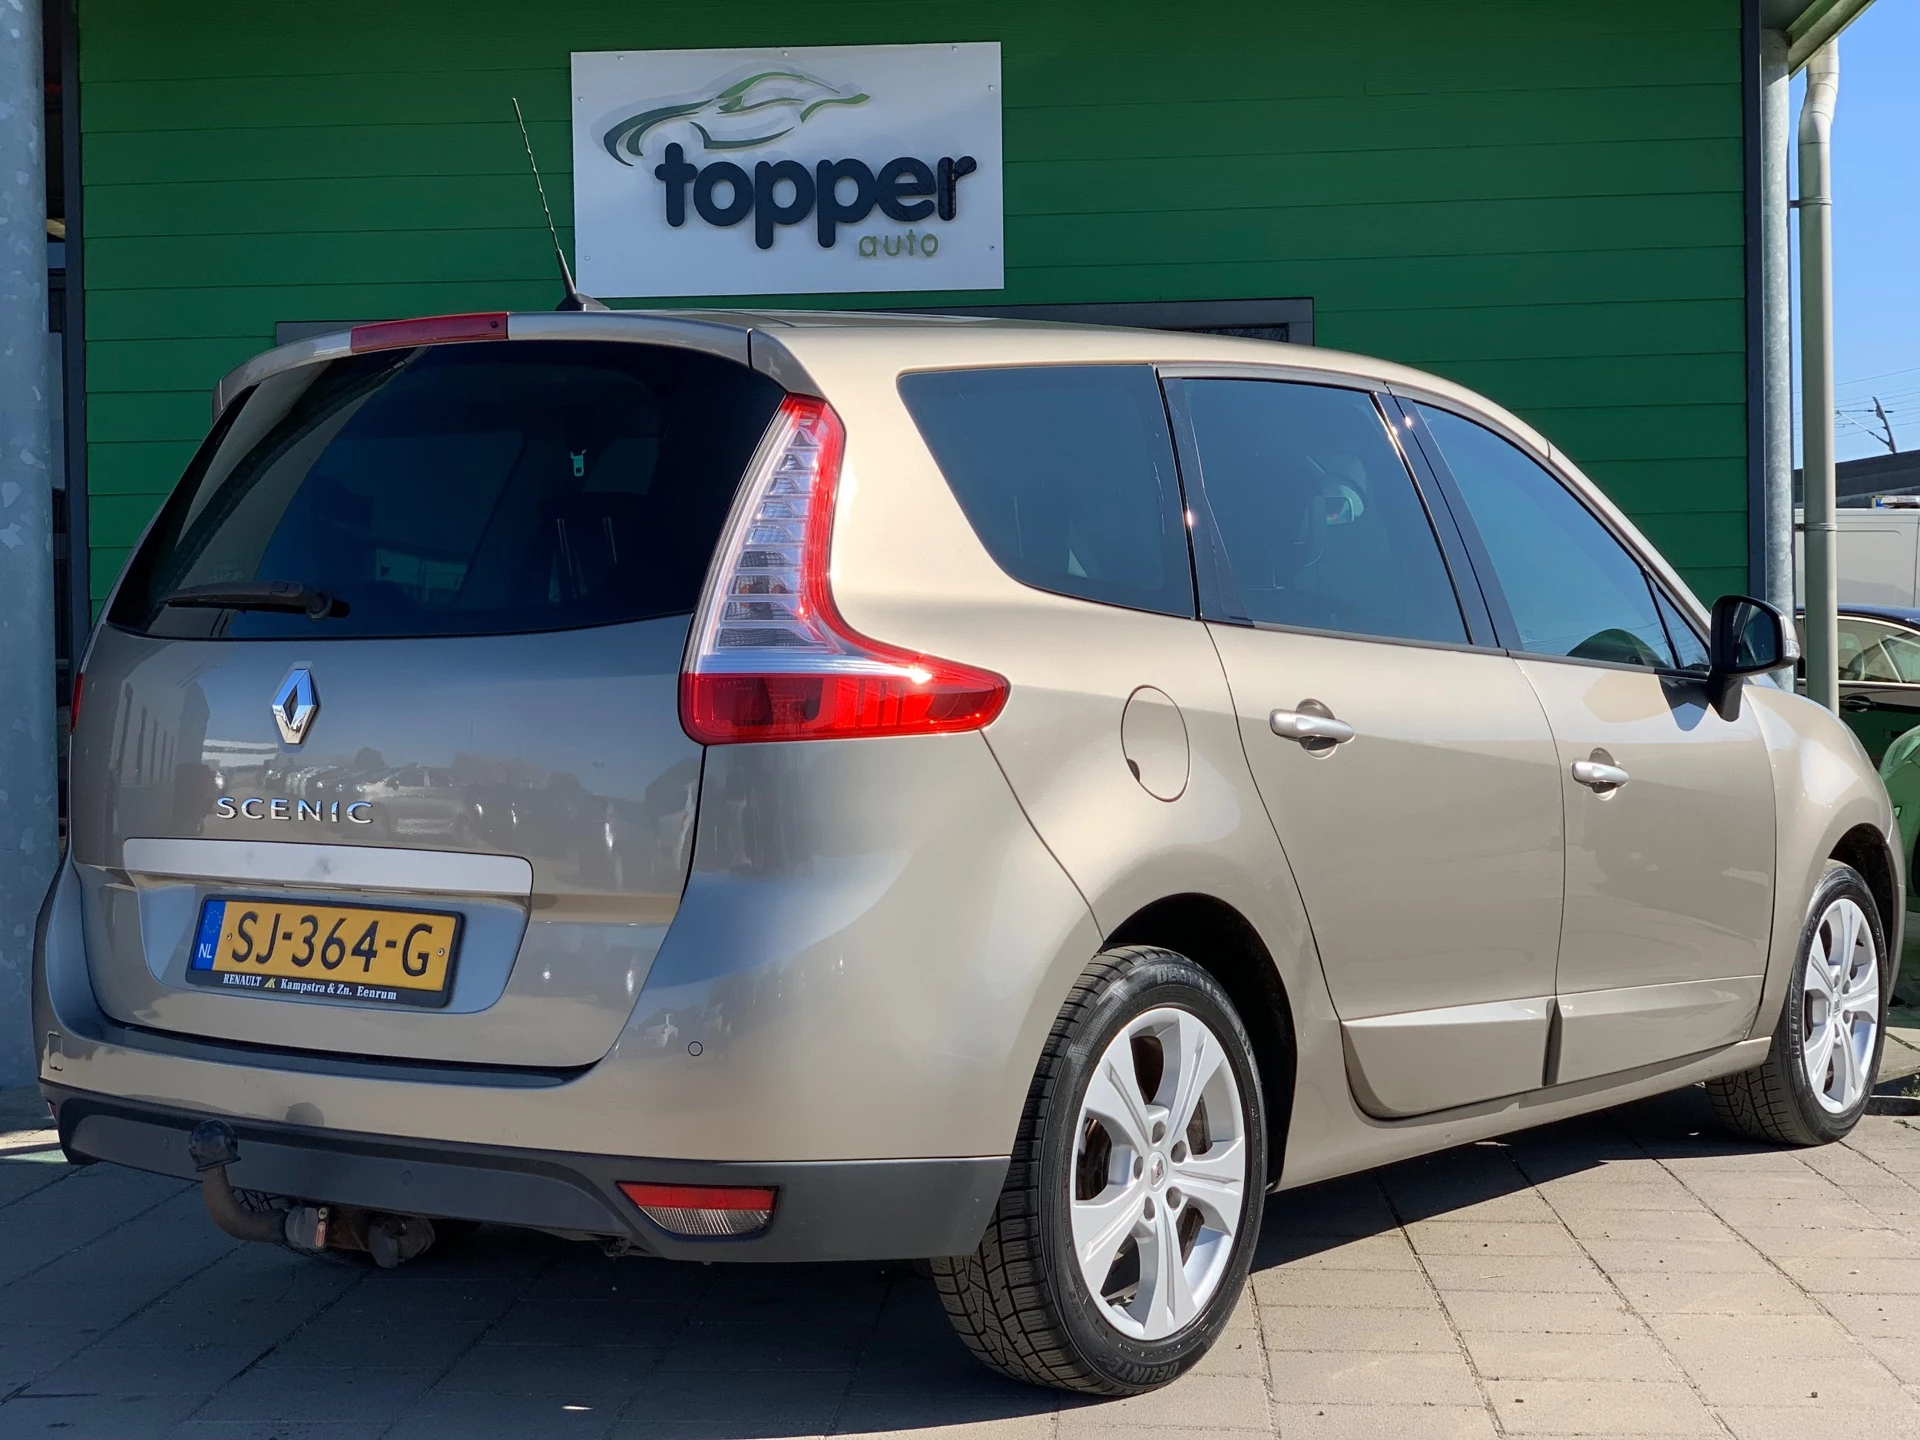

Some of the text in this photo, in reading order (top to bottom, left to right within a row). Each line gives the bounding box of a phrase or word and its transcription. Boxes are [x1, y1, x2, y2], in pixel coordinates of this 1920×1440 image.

[655, 142, 977, 249] topper
[859, 229, 939, 257] auto
[216, 797, 373, 824] SCENIC
[199, 943, 213, 959] NL
[231, 911, 433, 977] SJ-364-G
[223, 974, 397, 1000] RENAULT Kampstra & Zn. Eenrum
